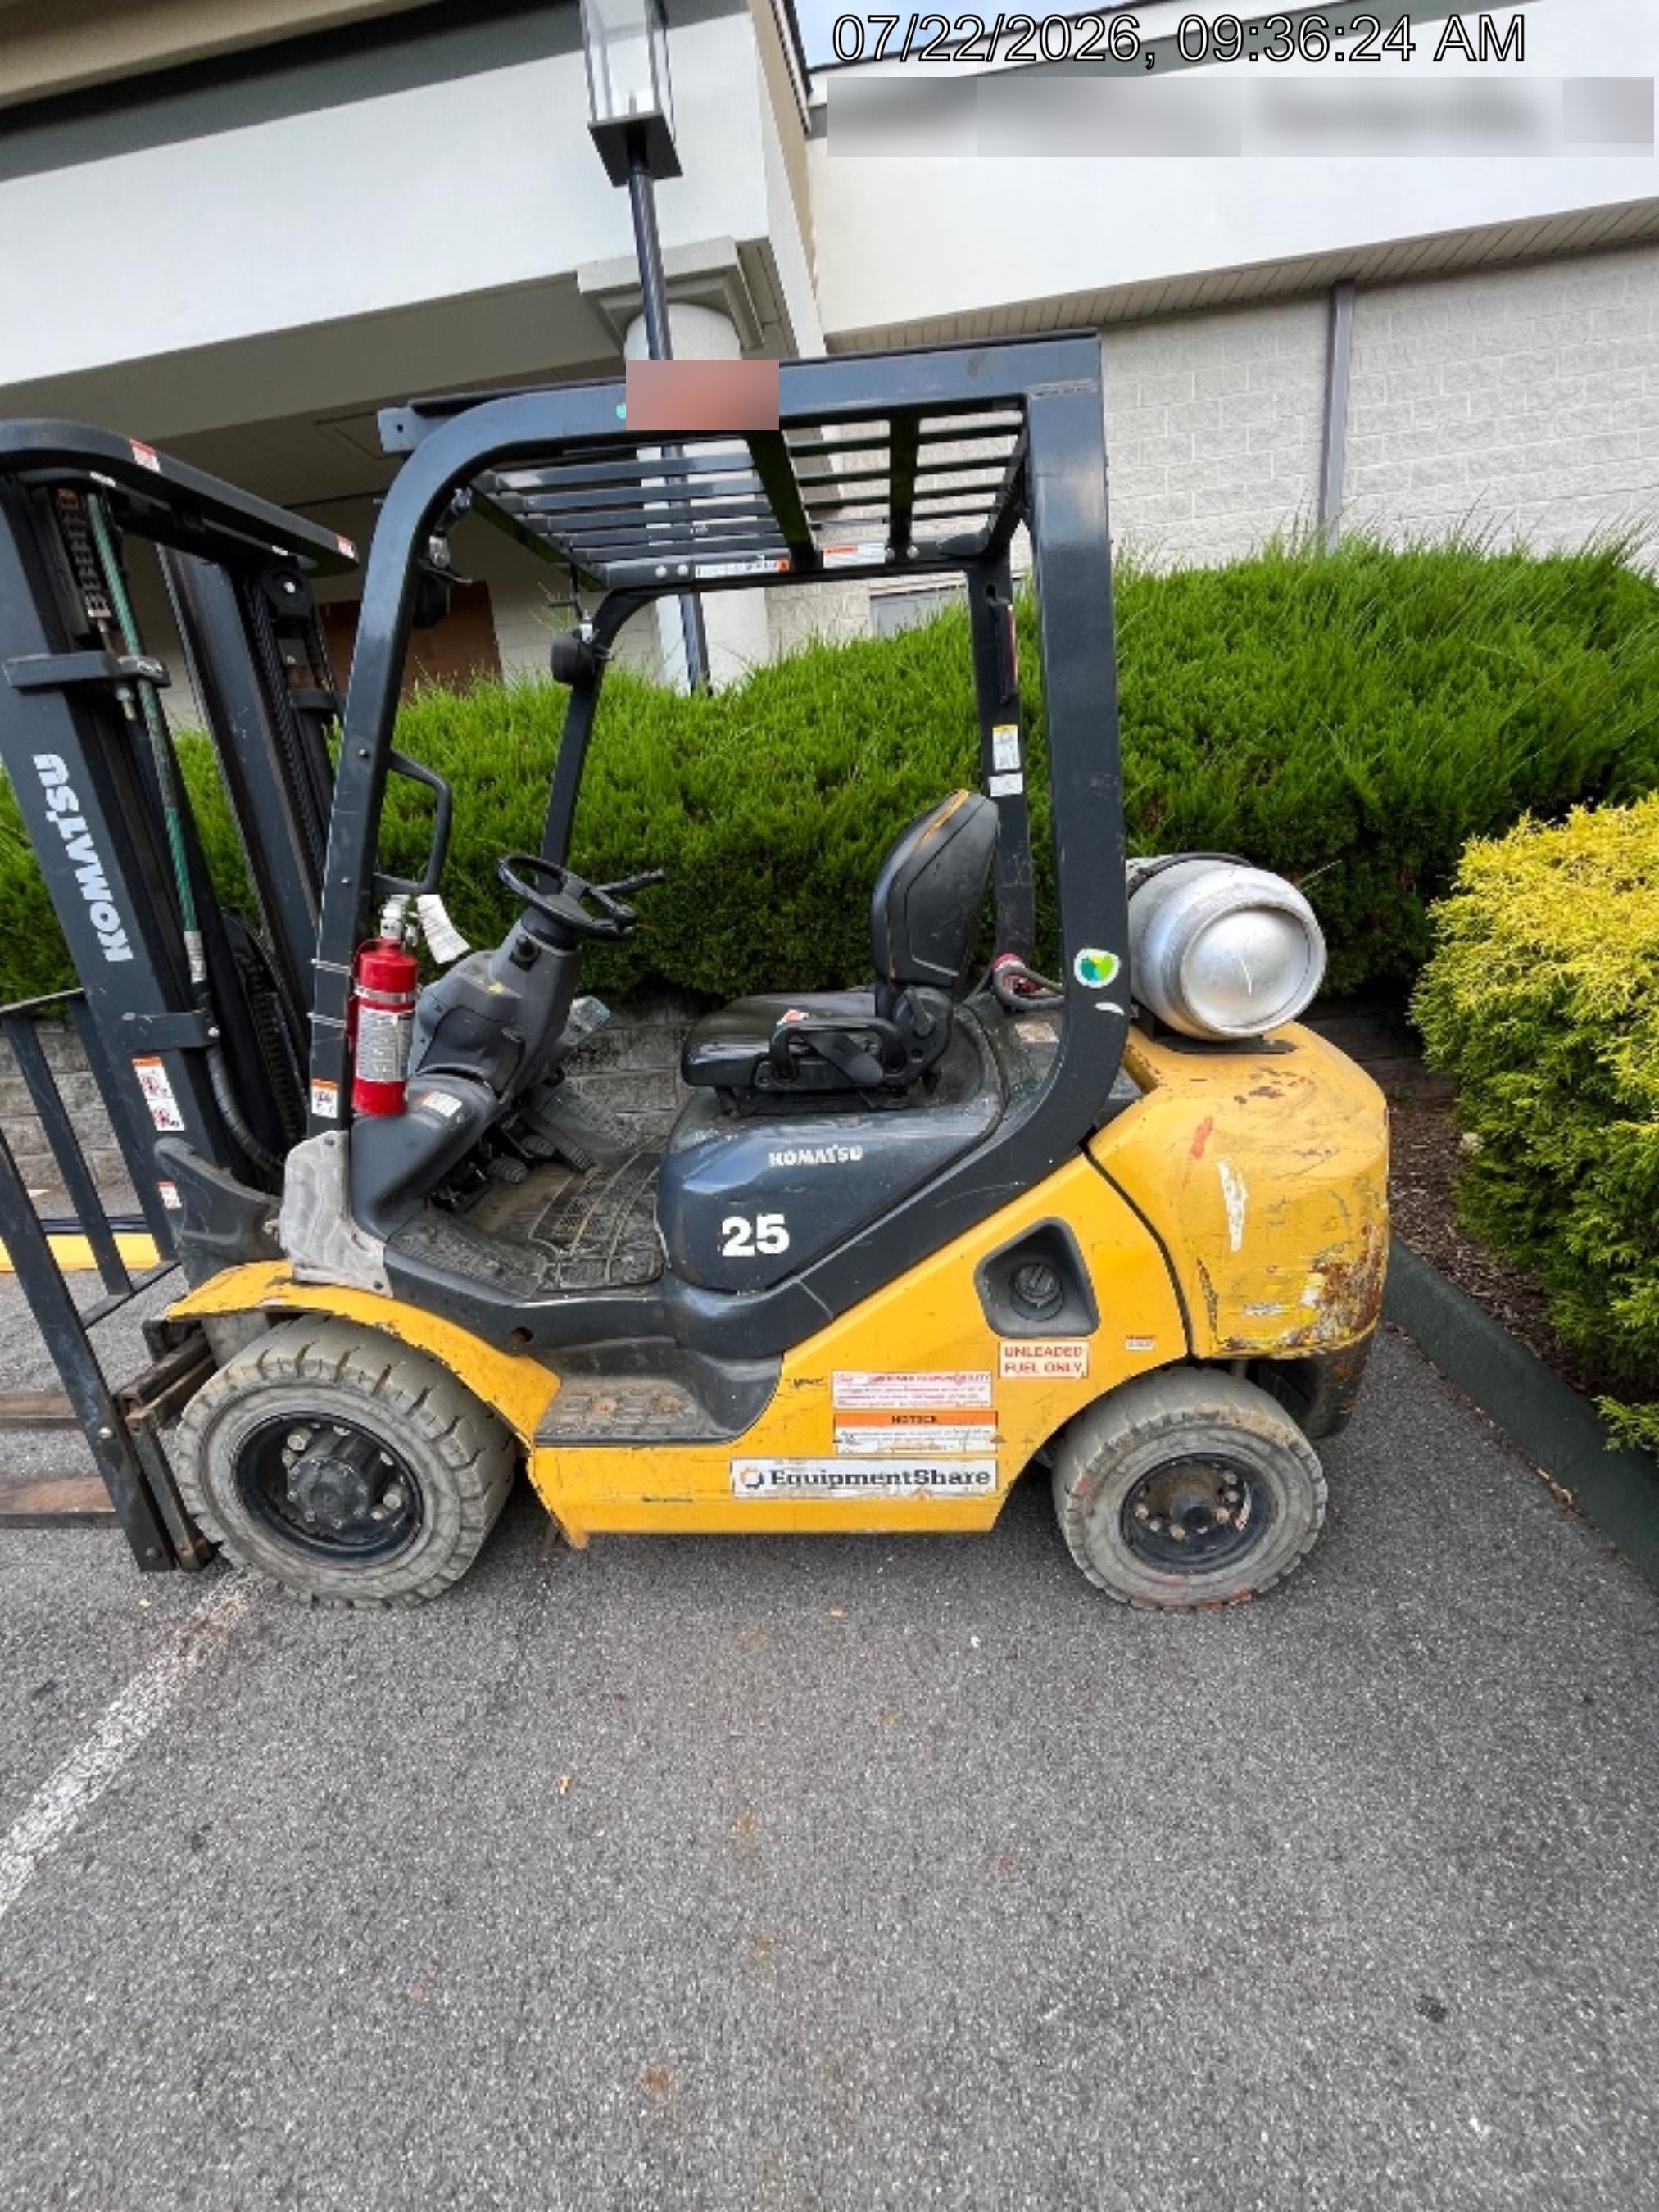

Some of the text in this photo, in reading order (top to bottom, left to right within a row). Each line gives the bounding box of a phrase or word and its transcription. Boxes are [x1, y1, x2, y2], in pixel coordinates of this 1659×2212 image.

[33, 754, 134, 962] KOMATSU
[769, 1144, 863, 1167] KOMATSU
[721, 1213, 790, 1257] 25
[1004, 1346, 1082, 1358] UNLEADED
[1004, 1362, 1082, 1374] FUEL ONLY
[769, 1468, 990, 1489] EquipmentShare
